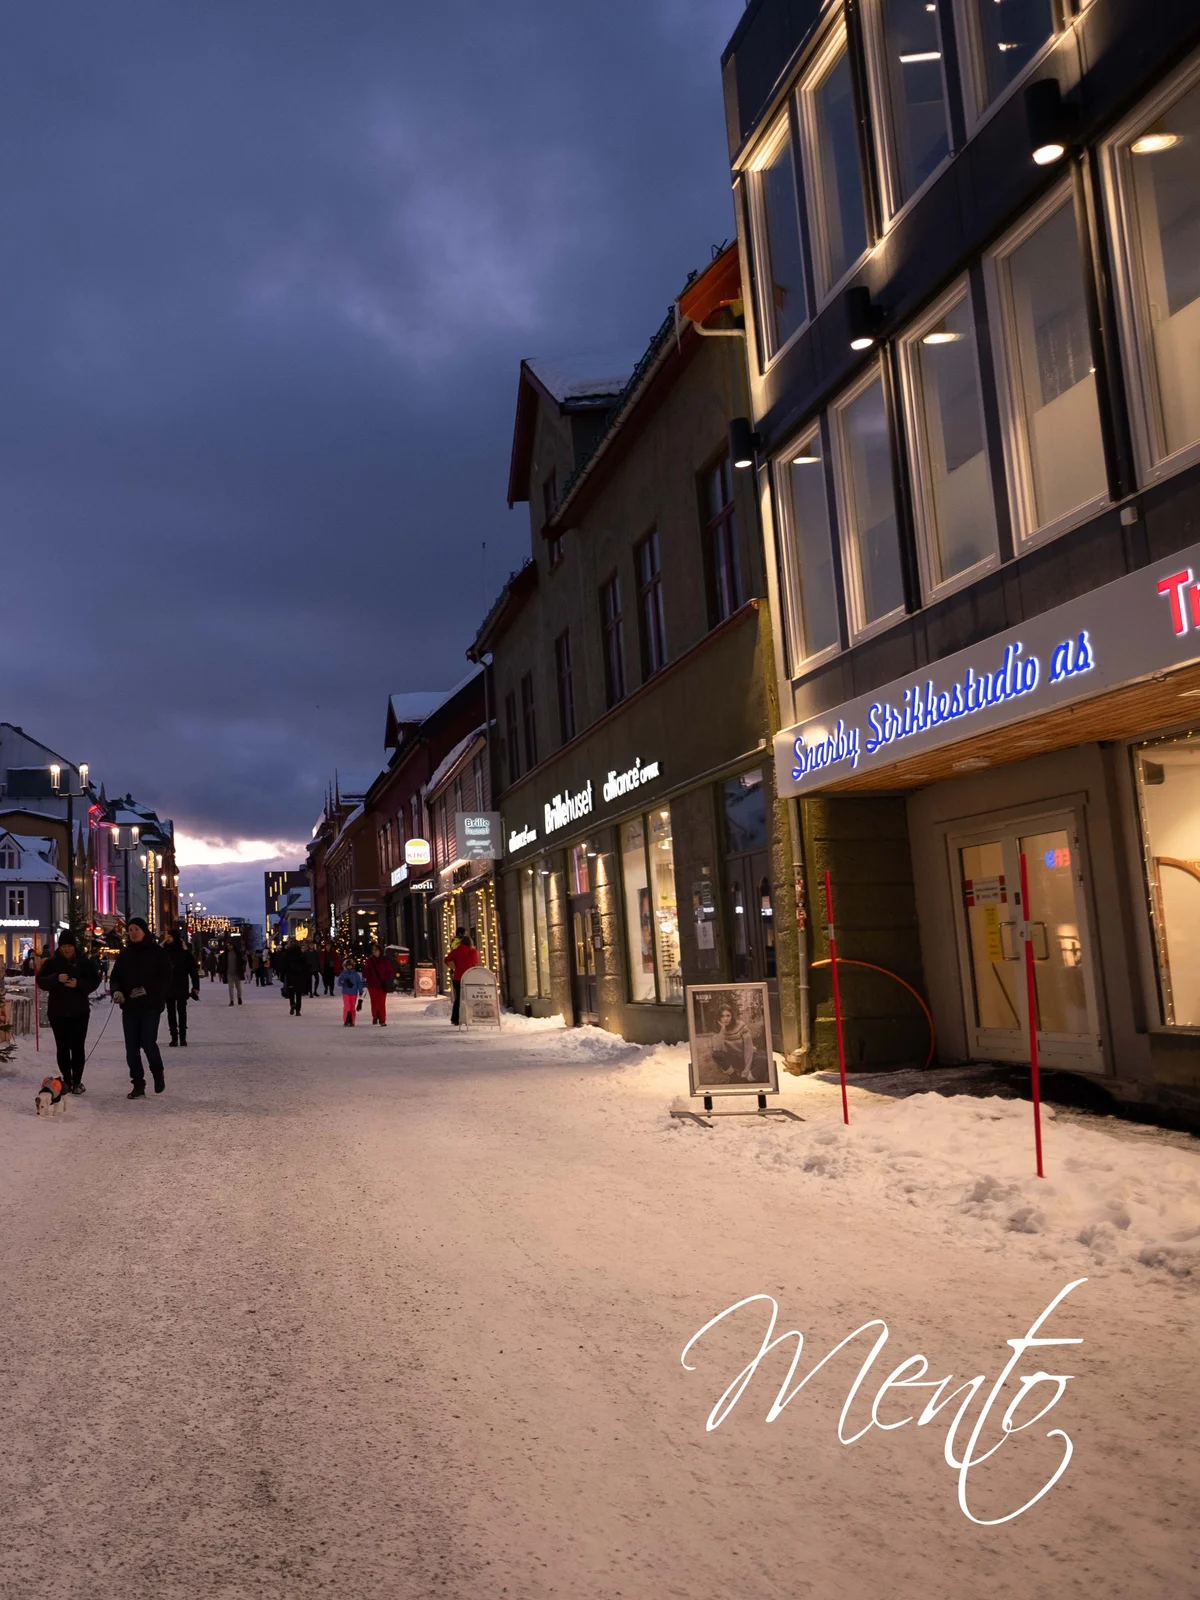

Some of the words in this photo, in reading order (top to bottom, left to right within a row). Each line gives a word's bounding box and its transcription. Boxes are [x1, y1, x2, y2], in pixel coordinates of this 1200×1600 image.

[791, 719, 859, 781] Snarby
[865, 642, 1040, 754] Strikkestudio
[1048, 631, 1094, 683] as
[603, 770, 640, 802] alliance
[464, 818, 490, 828] Brille
[544, 780, 593, 835] Brillehuset
[412, 881, 433, 890] norli
